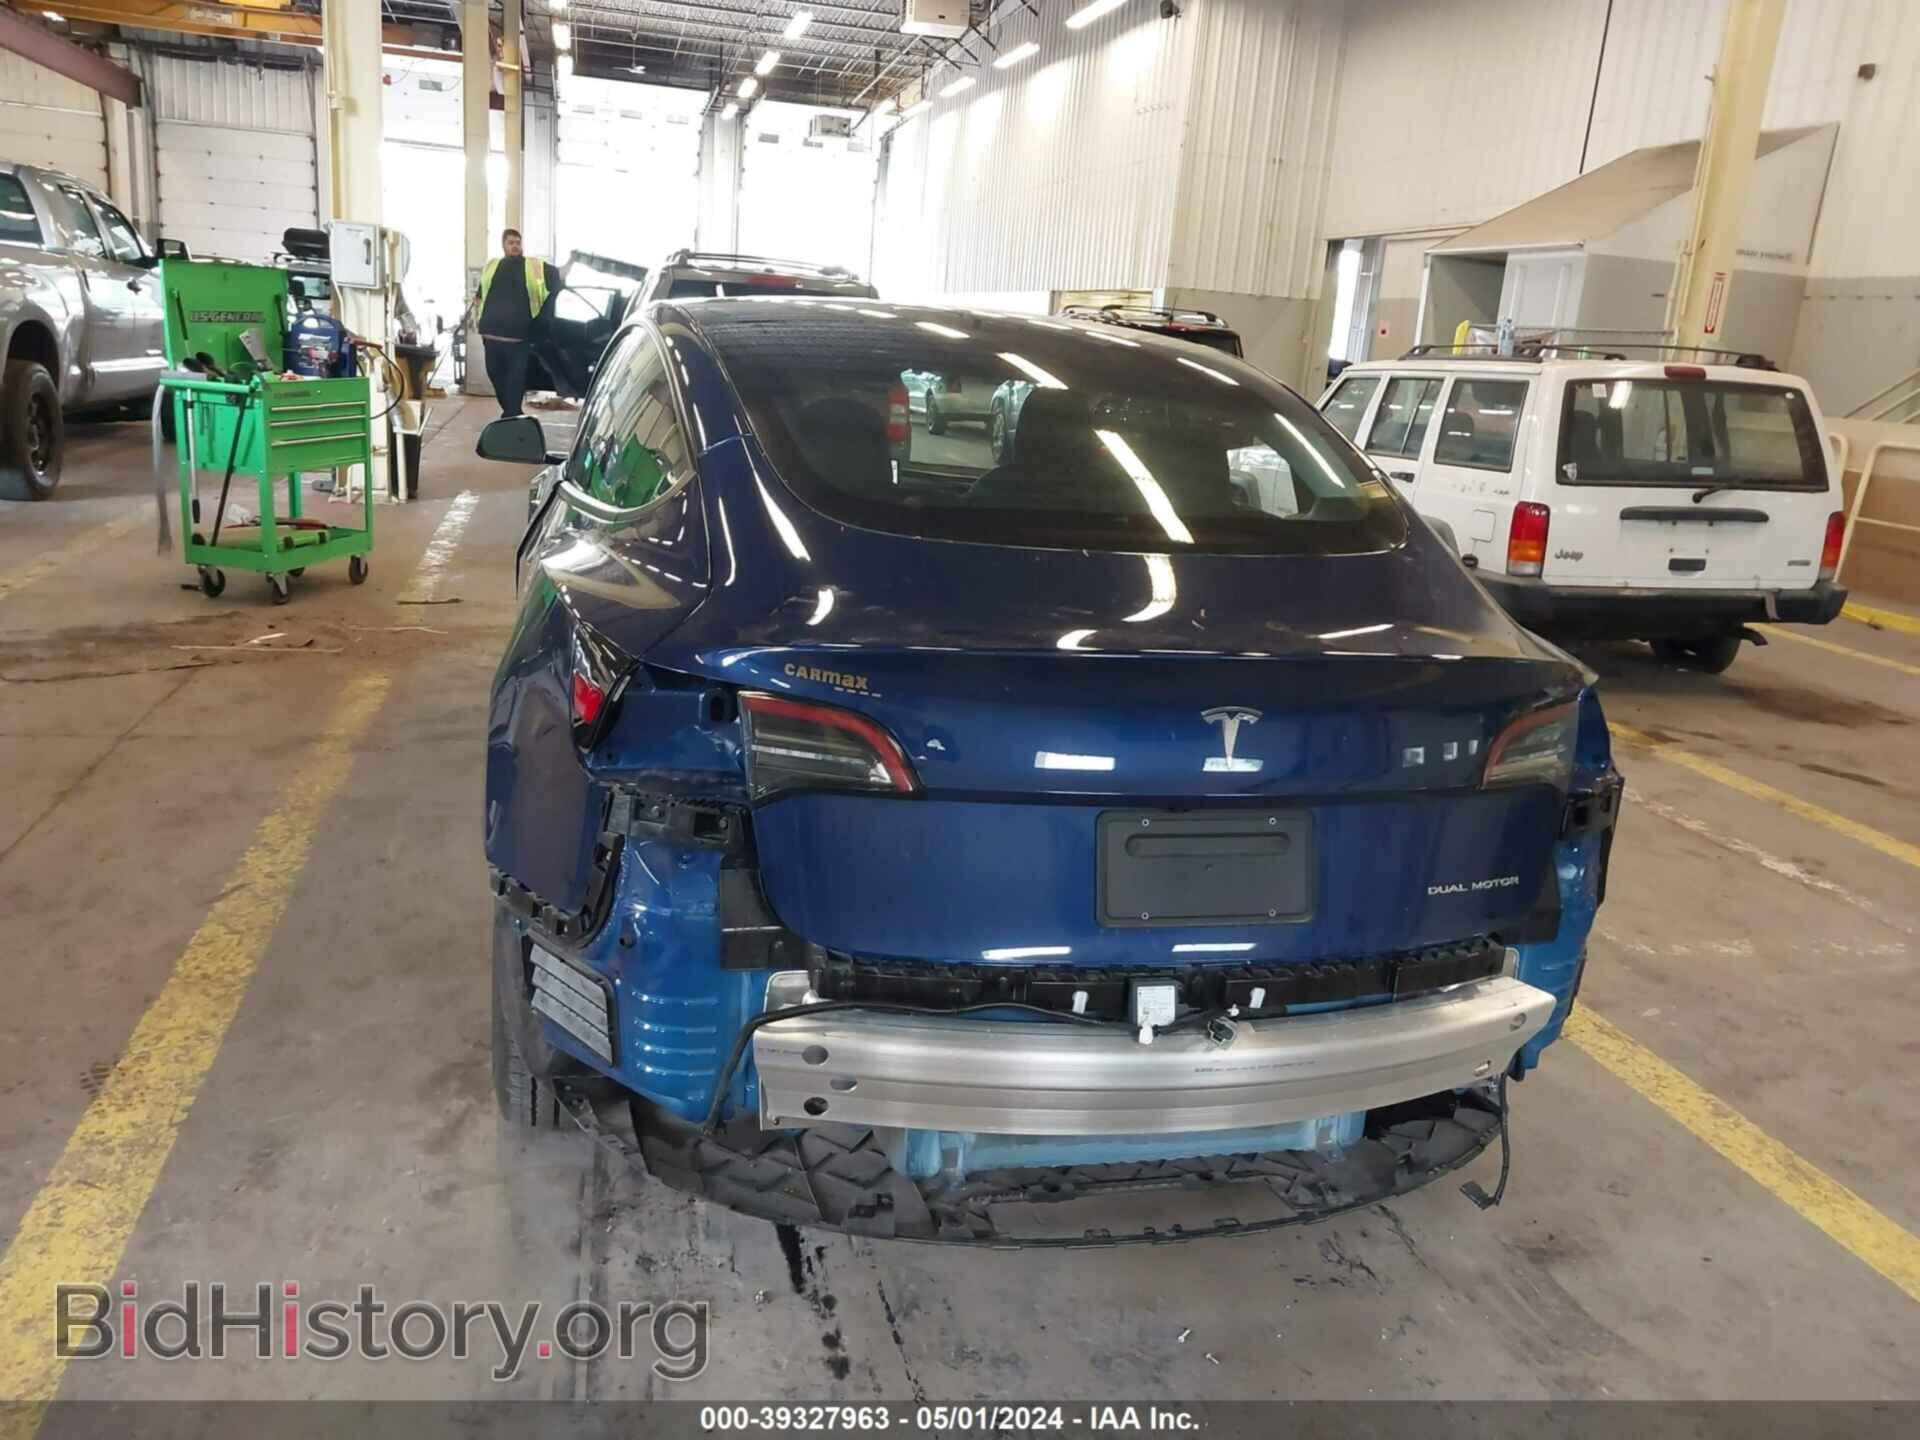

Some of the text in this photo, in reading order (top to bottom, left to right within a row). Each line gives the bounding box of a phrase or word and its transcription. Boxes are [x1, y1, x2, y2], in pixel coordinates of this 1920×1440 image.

[1554, 548, 1584, 562] Jeep
[1427, 875, 1519, 896] DUAL MOTOR
